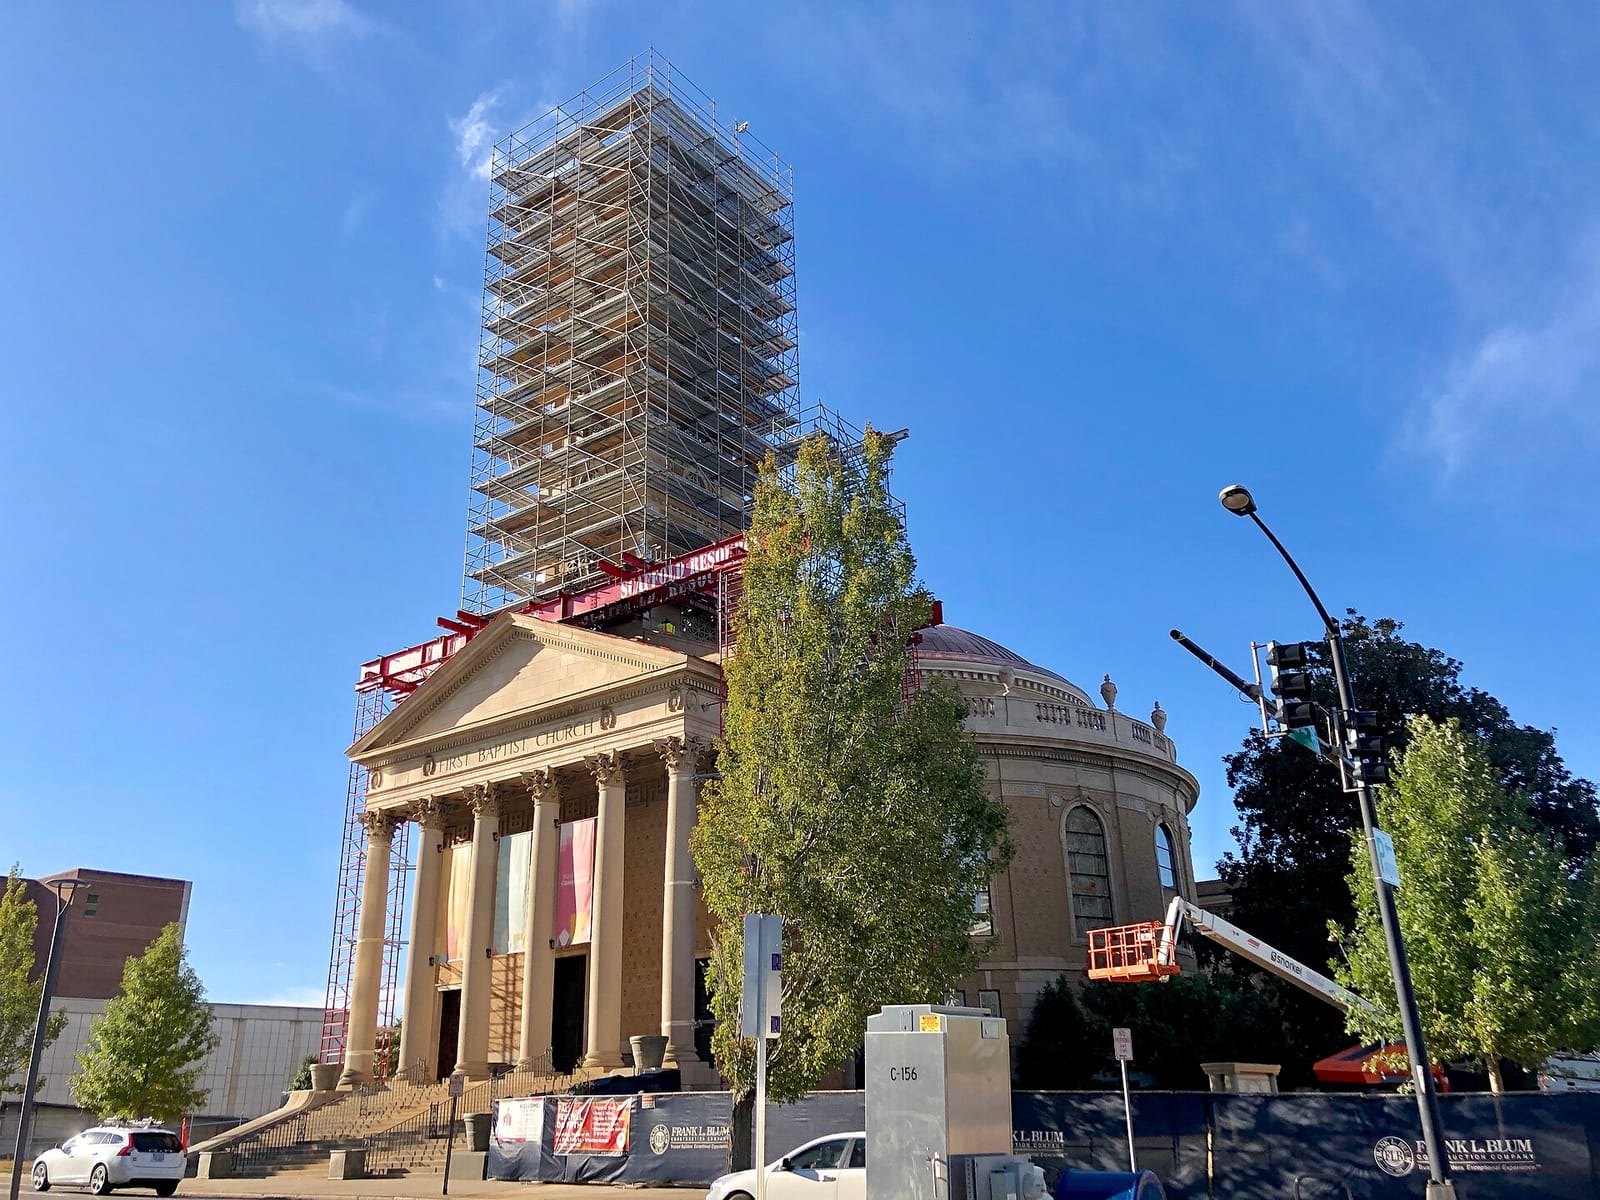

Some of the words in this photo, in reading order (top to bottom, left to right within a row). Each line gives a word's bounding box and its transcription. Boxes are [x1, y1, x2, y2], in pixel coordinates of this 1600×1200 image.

[438, 755, 469, 773] FIRST
[478, 736, 529, 763] BAPTIST
[535, 717, 594, 747] CHURCH
[1276, 955, 1303, 977] snorkel
[890, 1067, 918, 1081] C-156
[671, 1126, 698, 1137] FRANK
[699, 1126, 706, 1137] L.
[706, 1126, 730, 1137] BLUM
[1020, 1130, 1031, 1142] L.
[1031, 1130, 1065, 1143] BLUM
[1415, 1139, 1468, 1153] FNK
[1470, 1139, 1487, 1153] L.
[1486, 1139, 1534, 1153] BLUM
